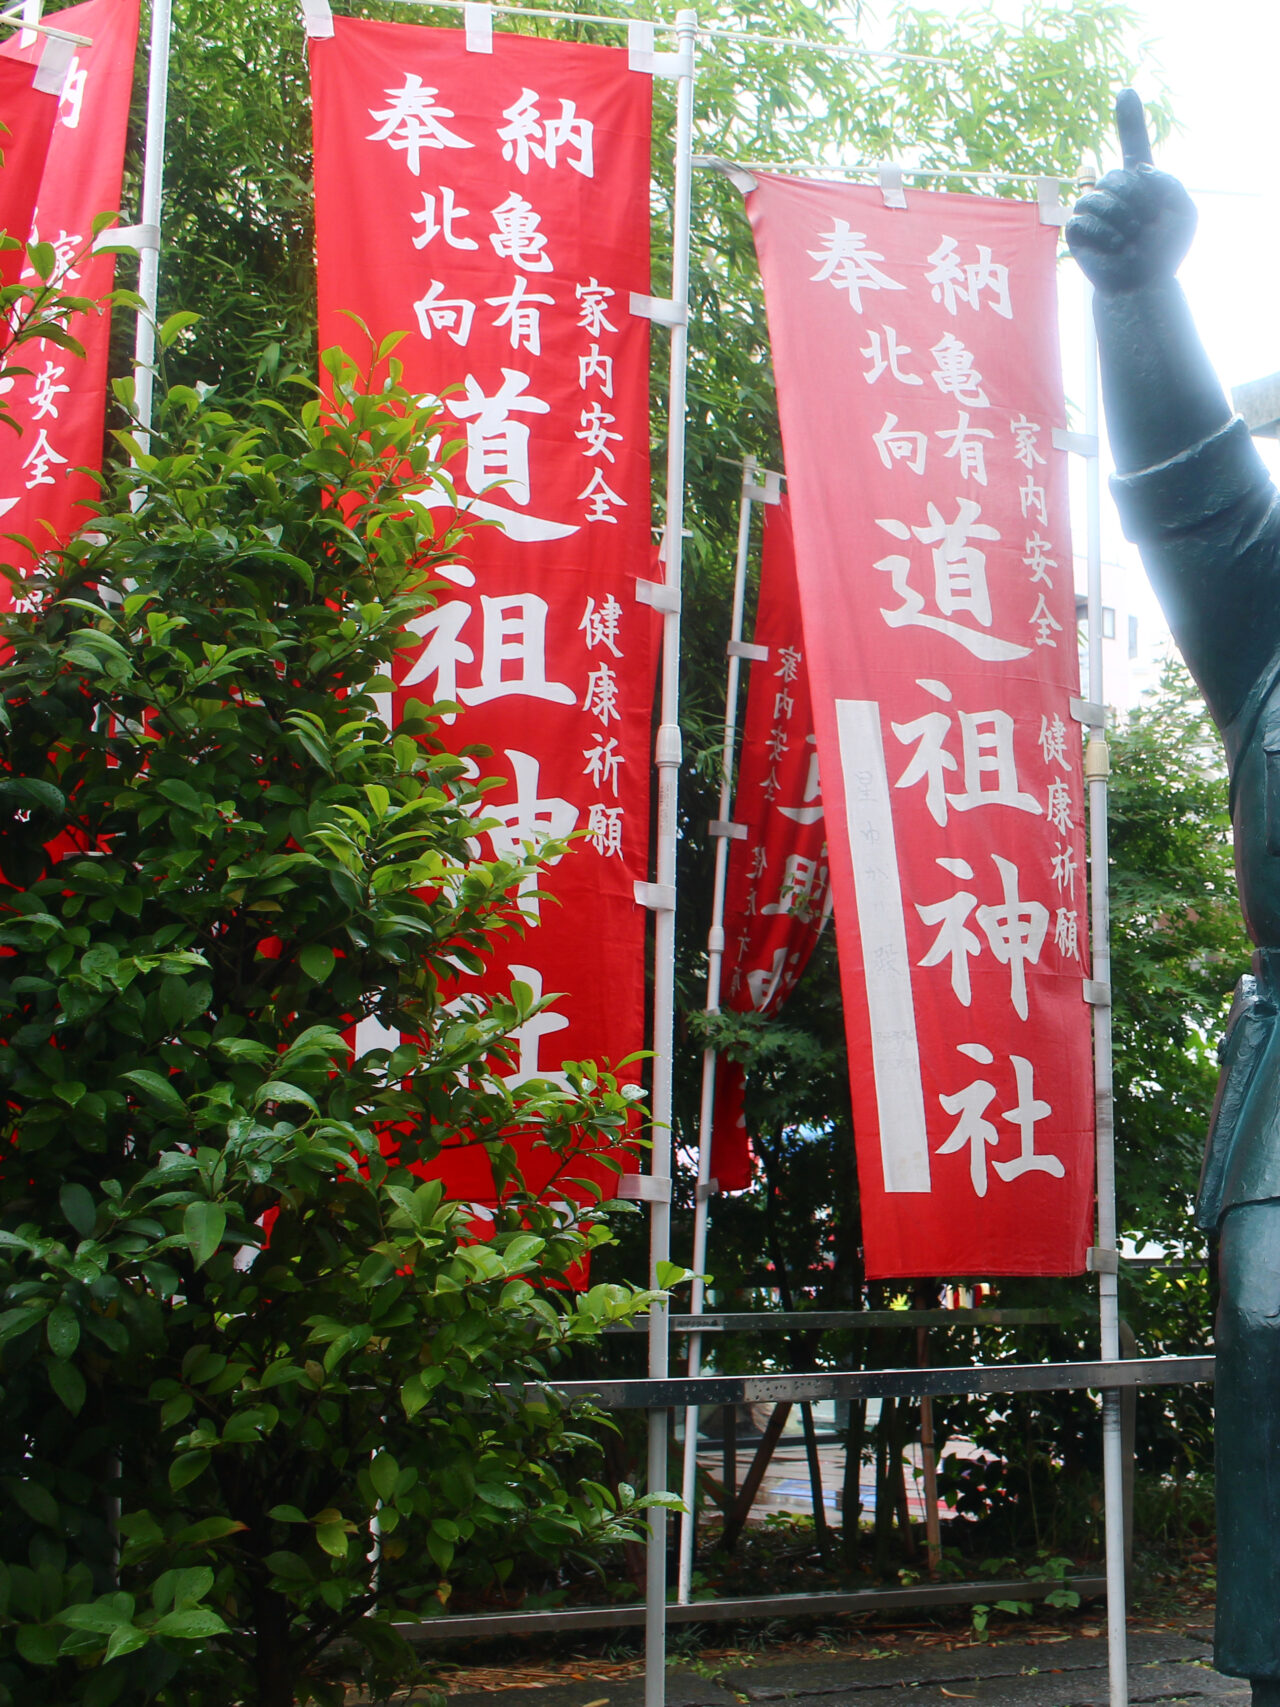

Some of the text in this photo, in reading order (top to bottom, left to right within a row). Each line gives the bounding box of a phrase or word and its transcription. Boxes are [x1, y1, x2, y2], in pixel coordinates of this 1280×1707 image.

[365, 72, 594, 178] 奉納
[411, 186, 479, 347] 北向
[484, 192, 555, 356] 亀有
[806, 215, 1014, 320] 奉納
[575, 277, 627, 524] 家内安全
[859, 324, 928, 475] 北向
[929, 331, 995, 486] 亀有
[1009, 414, 1064, 649] 家内安全
[399, 368, 581, 1098] 道祖神社
[578, 594, 625, 862] 健康祈願
[873, 497, 1065, 1198] 道祖神社
[1037, 712, 1080, 962] 健康祈願
